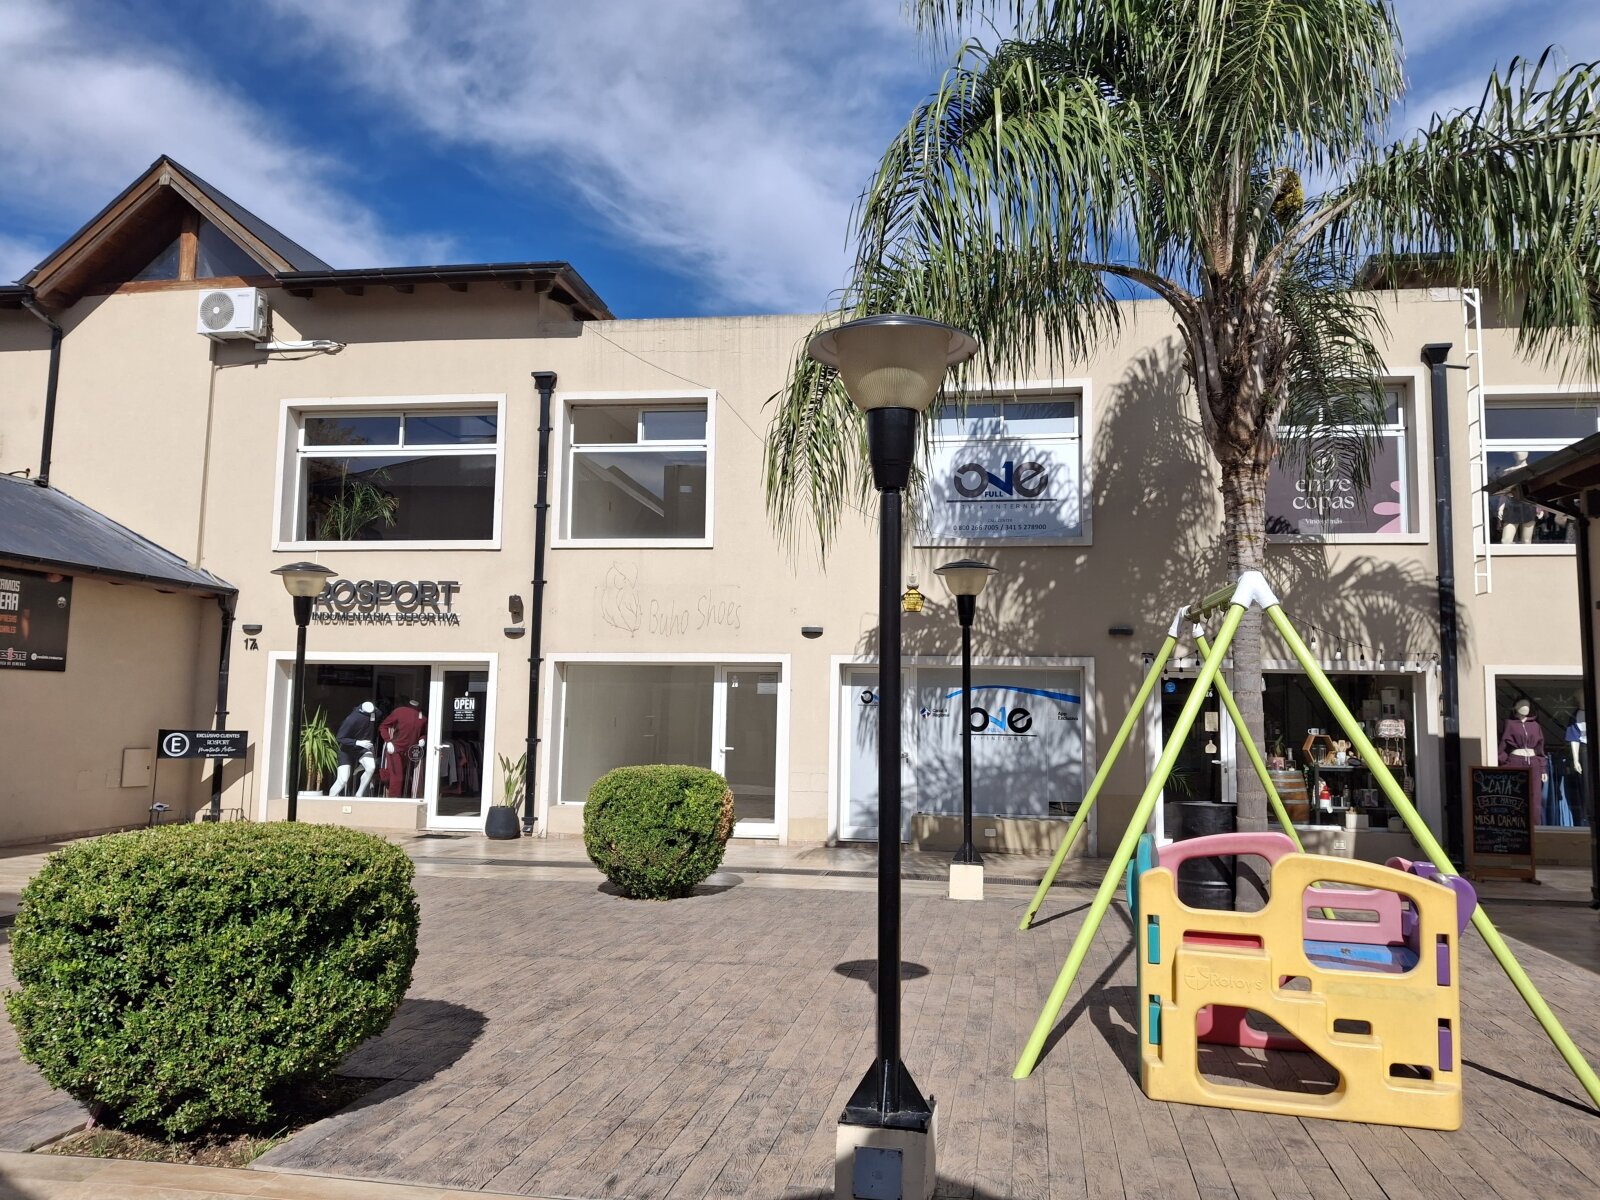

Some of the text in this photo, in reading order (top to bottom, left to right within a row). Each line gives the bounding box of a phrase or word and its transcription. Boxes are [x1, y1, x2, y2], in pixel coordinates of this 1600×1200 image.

[1292, 495, 1355, 515] copas
[315, 579, 460, 606] ROSPORT
[697, 588, 742, 630] Shoes
[312, 612, 459, 623] INDUMENTARIA DEPORTIVA
[454, 699, 475, 710] OPEN
[171, 737, 182, 752] E
[1488, 779, 1512, 795] CATA
